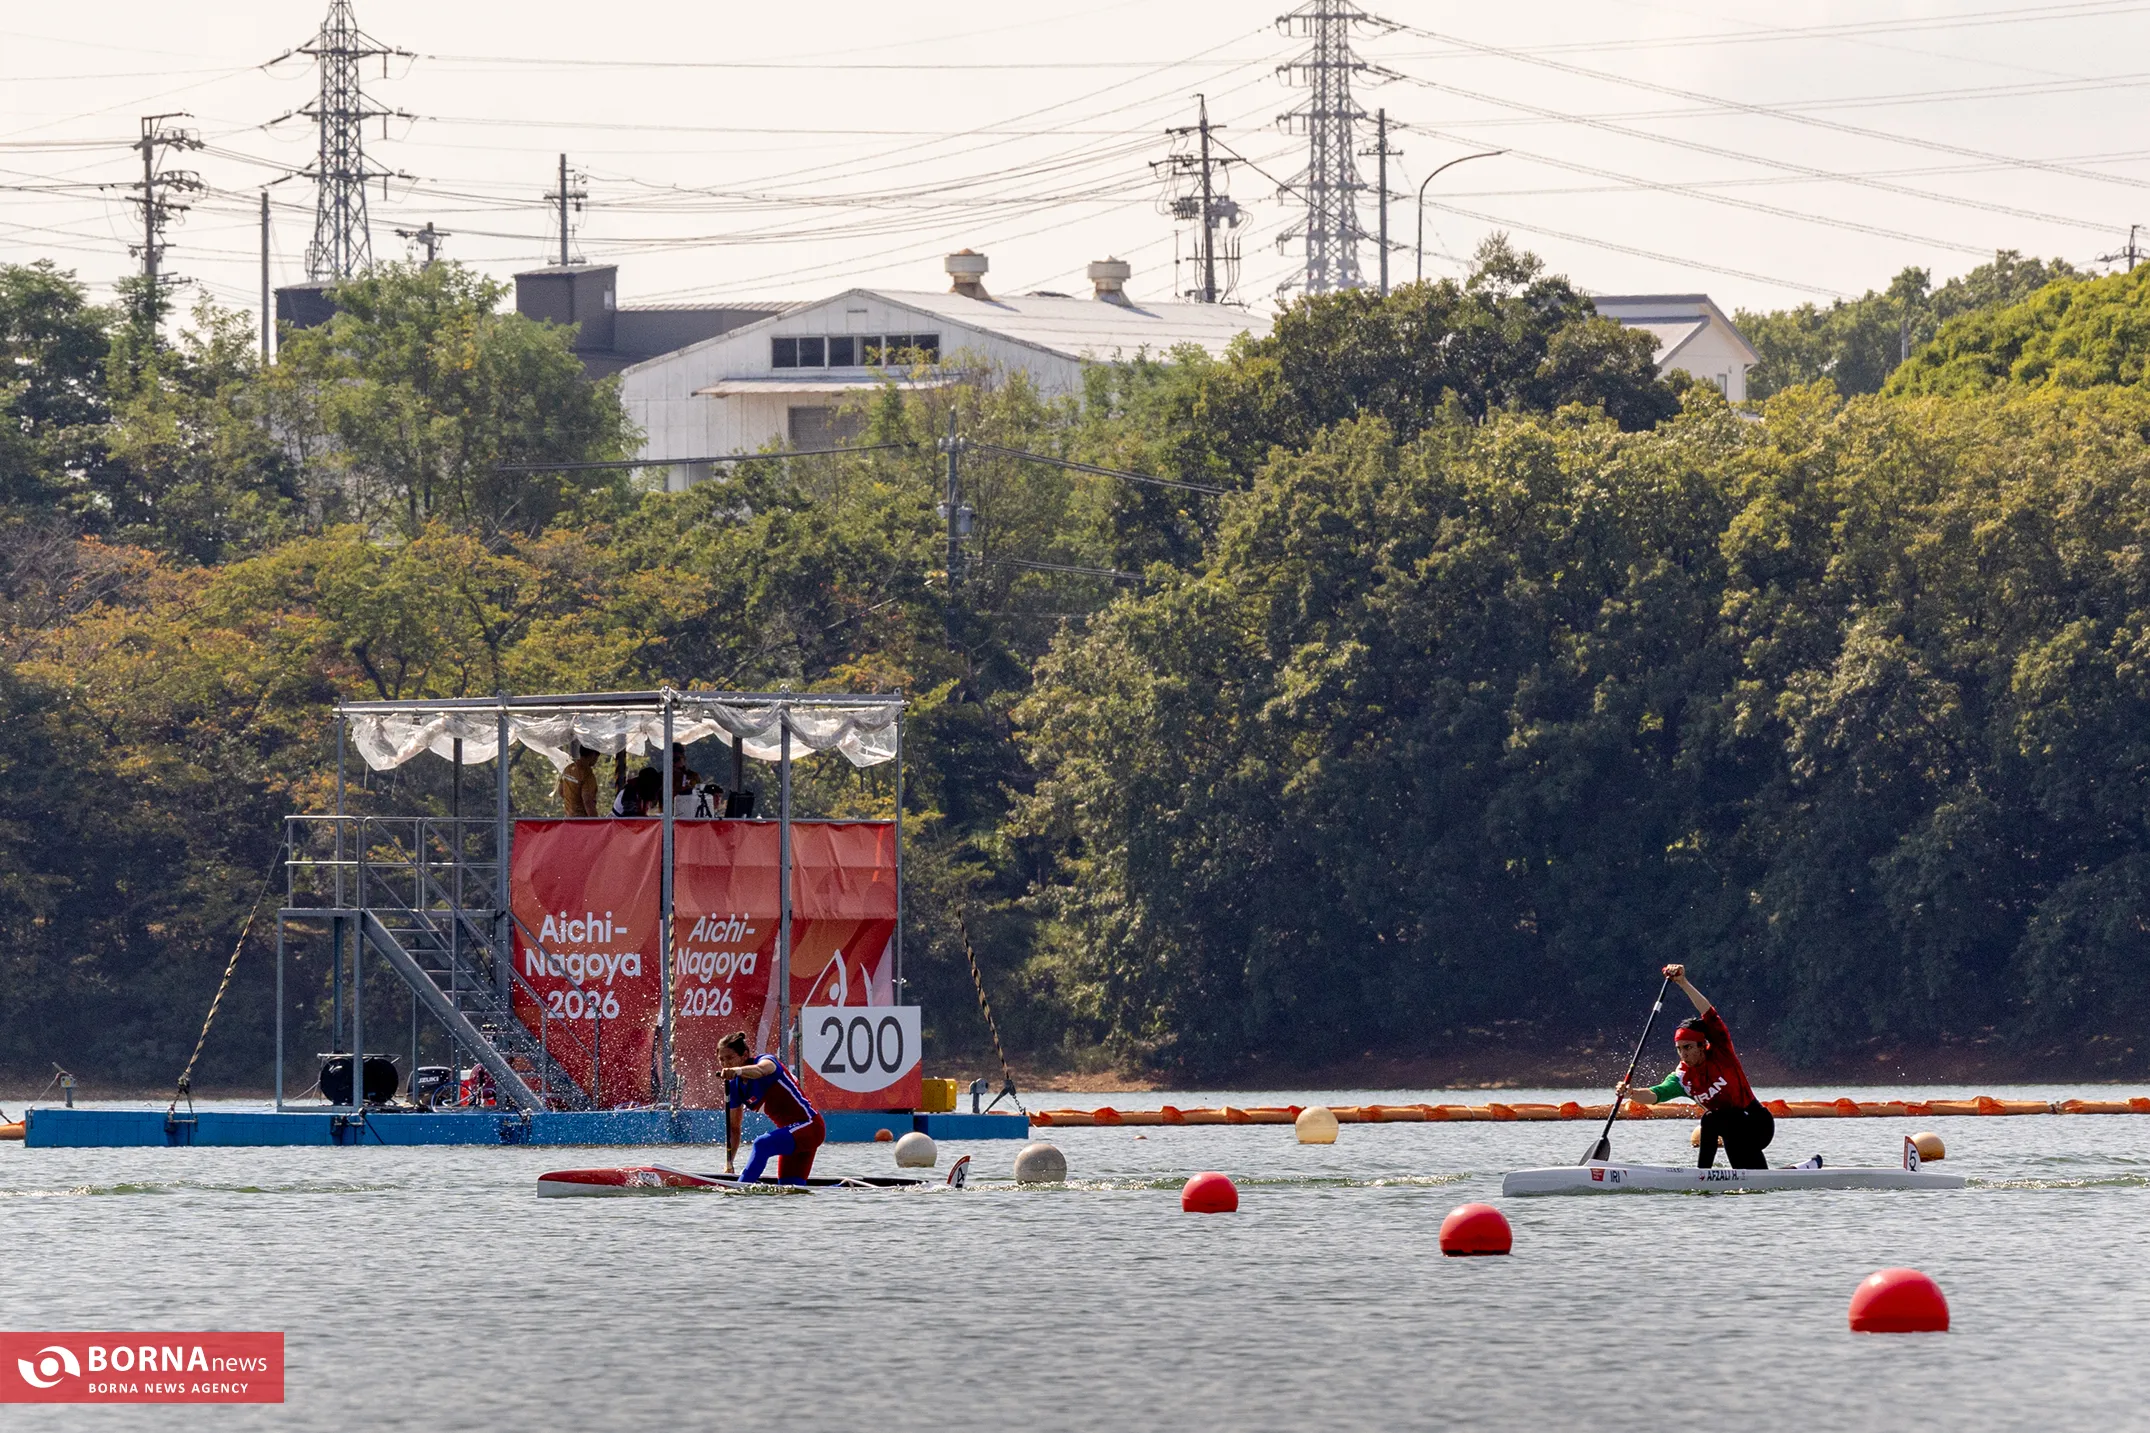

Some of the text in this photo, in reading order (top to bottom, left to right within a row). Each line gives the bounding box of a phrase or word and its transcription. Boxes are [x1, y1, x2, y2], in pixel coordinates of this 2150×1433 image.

[539, 911, 627, 943] Aichi-
[688, 912, 755, 943] Aichi-
[525, 948, 641, 986] Nagoya
[677, 947, 758, 983] Nagoya
[547, 990, 620, 1019] 2026
[681, 988, 733, 1017] 2026
[820, 1016, 904, 1074] 200
[1909, 1150, 1917, 1169] 5
[1610, 1169, 1621, 1183] IRI
[1707, 1169, 1731, 1181] AFZALI
